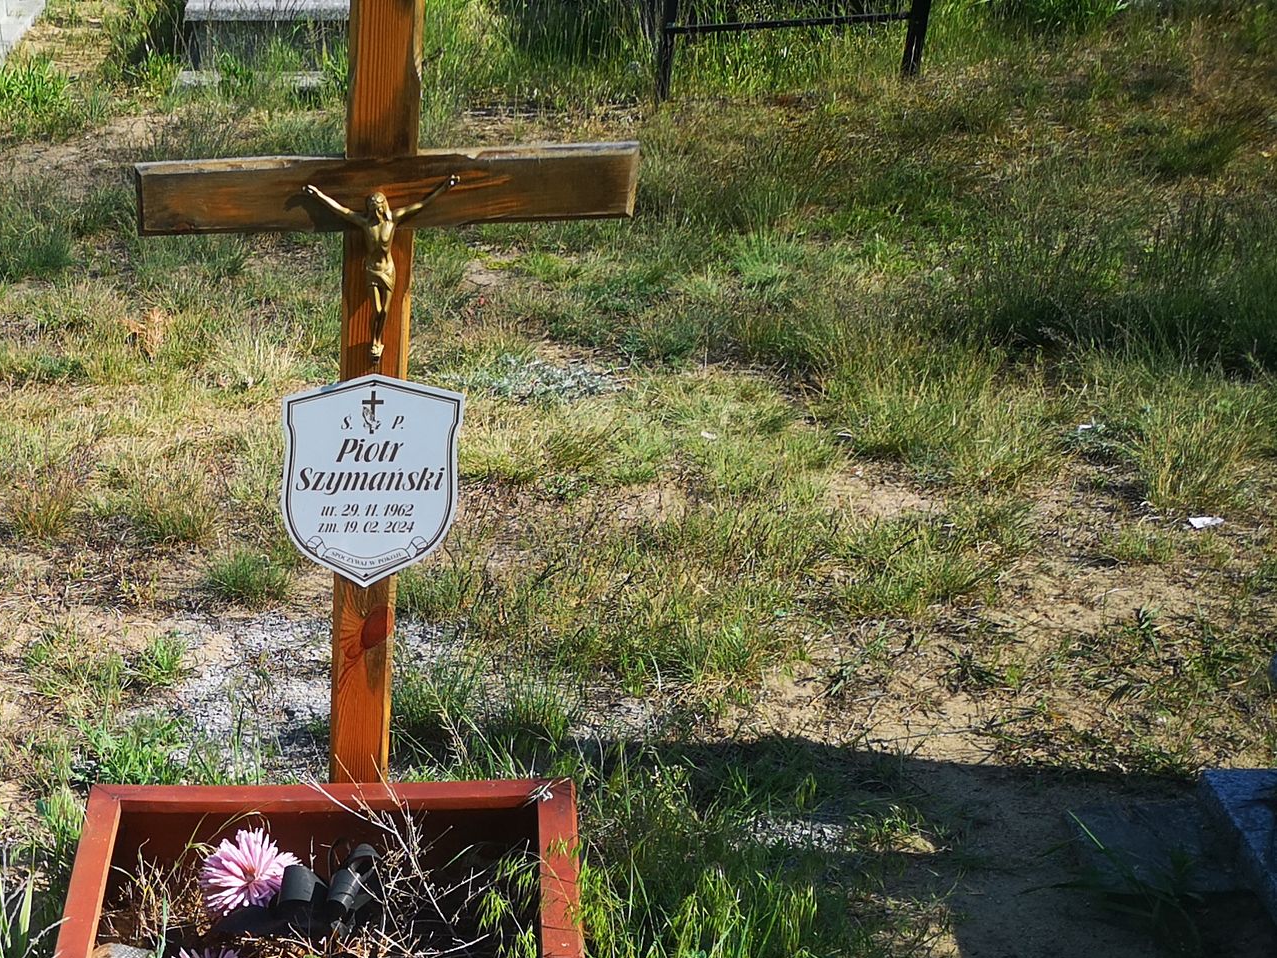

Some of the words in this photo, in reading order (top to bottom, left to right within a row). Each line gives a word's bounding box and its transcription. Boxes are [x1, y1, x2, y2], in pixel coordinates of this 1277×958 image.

[391, 415, 404, 430] P.
[336, 438, 403, 462] Piotr
[296, 467, 444, 495] Szymański
[320, 505, 337, 517] ur.
[341, 503, 360, 517] 29.
[365, 503, 378, 517] 11.
[383, 503, 414, 517] 1962
[318, 522, 339, 533] zm.
[343, 521, 358, 533] 19.
[363, 521, 380, 533] 02.
[384, 521, 415, 533] 2024
[331, 551, 368, 566] SPOCZYWAJ
[378, 552, 402, 564] POKOJU
